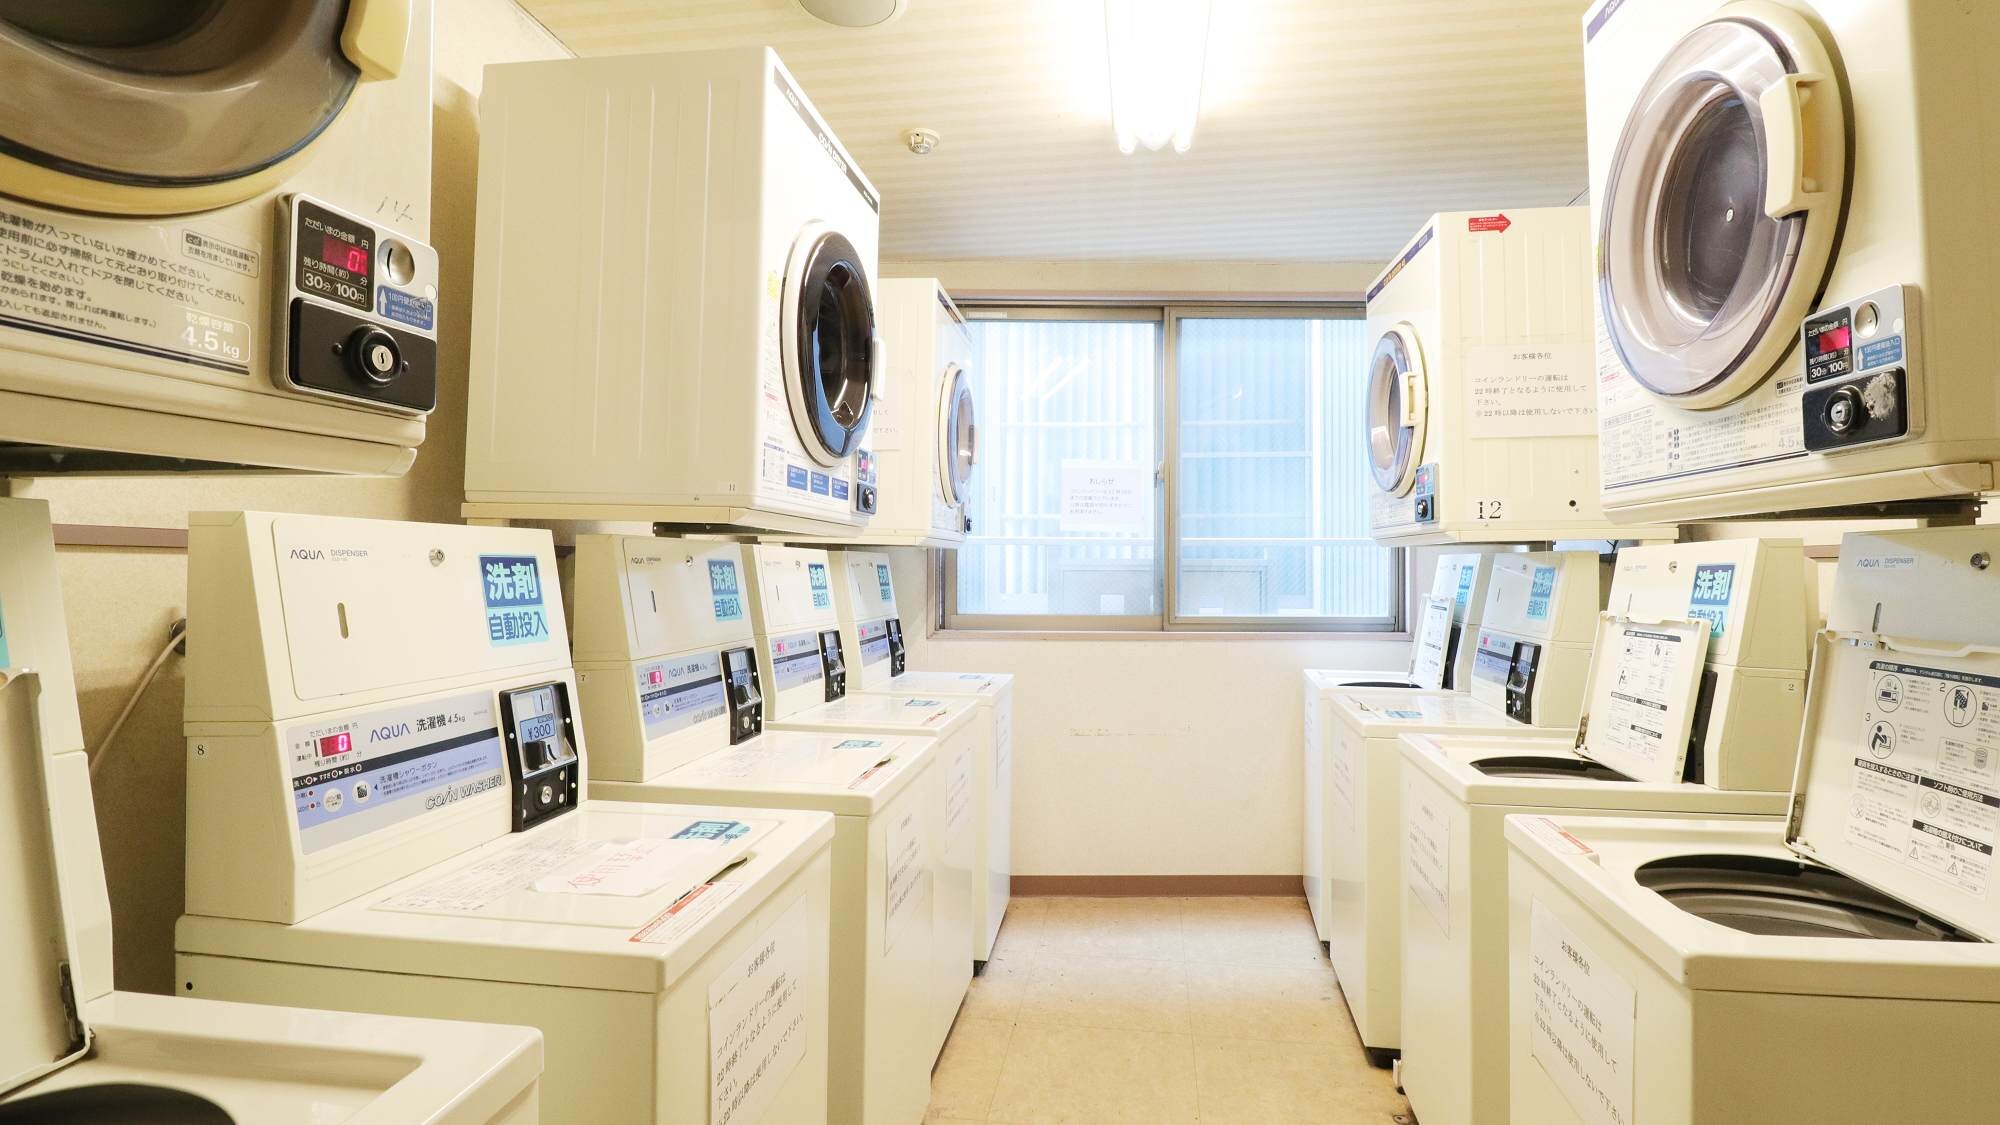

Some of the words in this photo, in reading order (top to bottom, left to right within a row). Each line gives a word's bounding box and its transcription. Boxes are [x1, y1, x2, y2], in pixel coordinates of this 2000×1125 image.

[305, 217, 356, 243] ただいまの金額
[361, 239, 369, 250] 円
[305, 272, 365, 303] 30分/100円
[360, 276, 368, 286] 分
[182, 326, 219, 351] 4.5
[223, 341, 240, 358] kg
[1472, 374, 1569, 383] コインランドリーの運転は
[1476, 501, 1502, 519] 12
[290, 549, 325, 560] AQUA
[330, 549, 368, 557] DISPENSER
[1857, 558, 1879, 568] AQUA
[486, 562, 539, 601] 洗剤
[711, 565, 736, 591] 洗剤
[809, 566, 826, 589] 洗剤
[1693, 570, 1732, 601] 洗剤
[715, 598, 743, 618] 自動投入
[488, 611, 549, 641] 自動投入
[1788, 683, 1794, 691] 2
[1939, 683, 1946, 692] 2
[1865, 712, 1871, 721] 3
[370, 722, 411, 743] AQUA
[416, 714, 447, 733] 洗濯機
[528, 723, 551, 741] ¥300
[197, 744, 205, 755] 8
[338, 734, 347, 751] 0
[425, 785, 459, 809] COIN
[459, 775, 502, 799] WASHER
